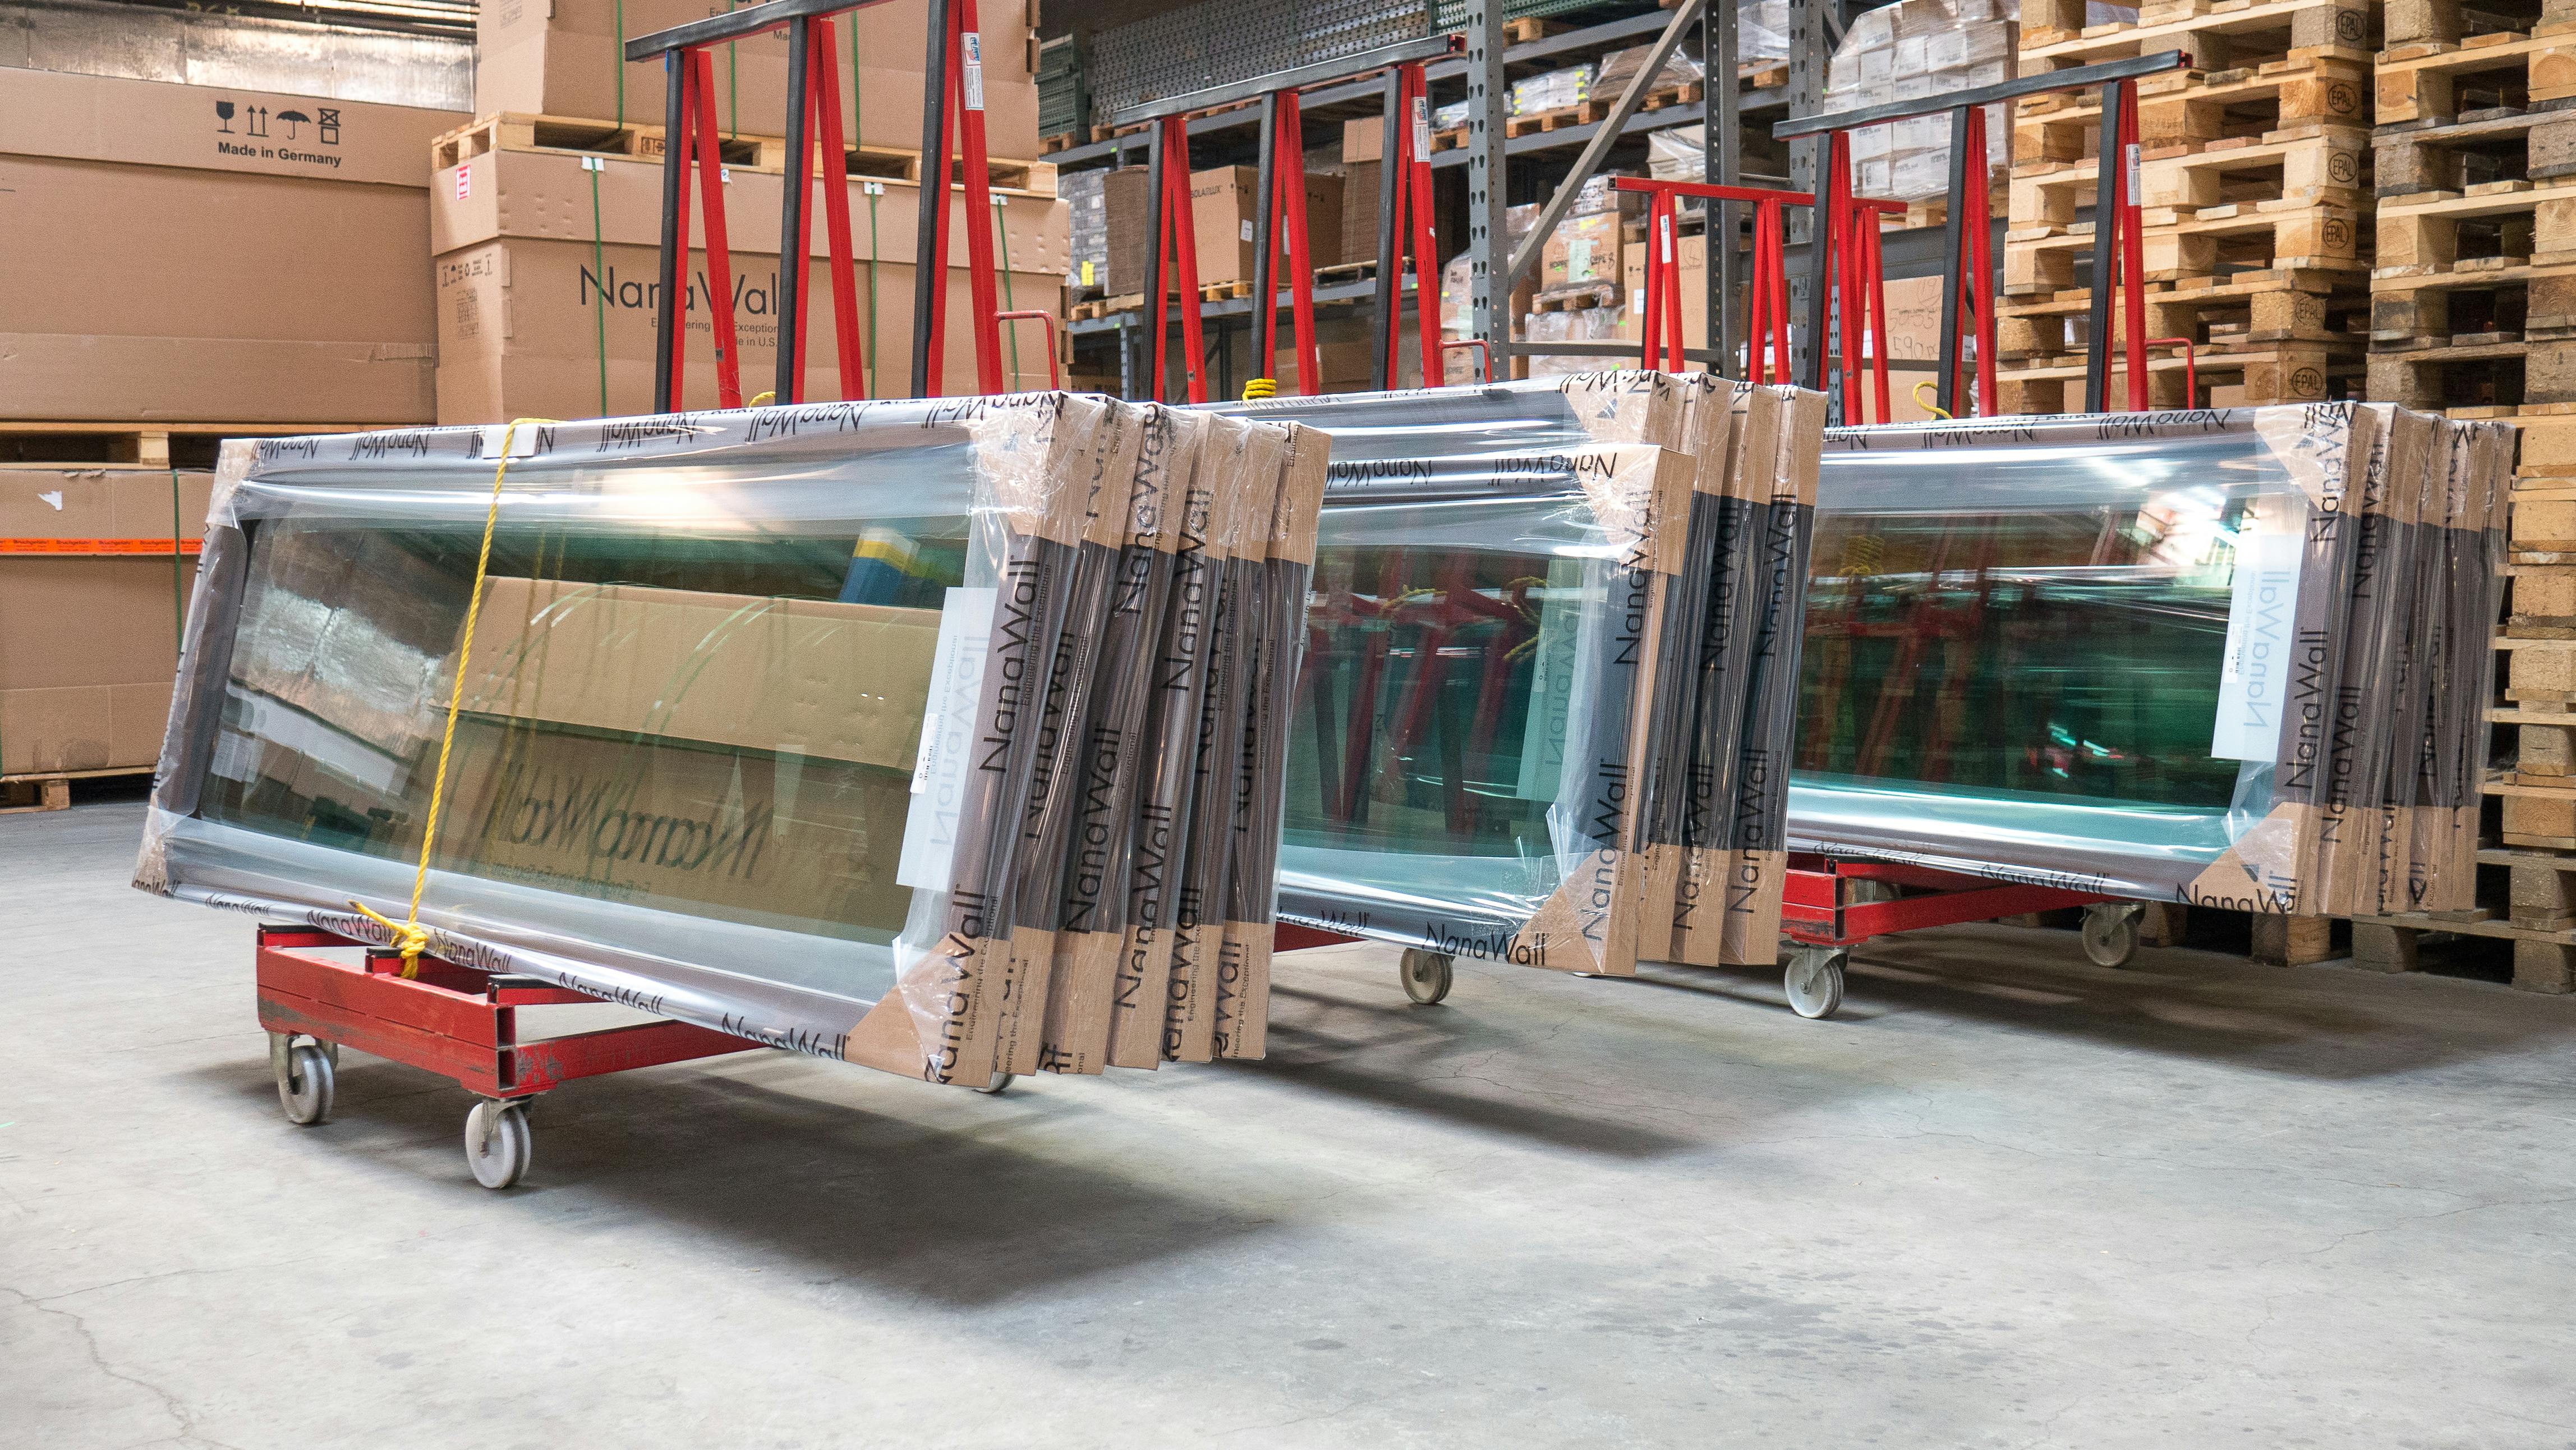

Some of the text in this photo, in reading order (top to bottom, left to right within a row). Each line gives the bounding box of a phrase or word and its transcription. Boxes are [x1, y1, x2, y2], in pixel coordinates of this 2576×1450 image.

[218, 141, 341, 168] Made in Germany
[580, 264, 777, 315] NanWal
[651, 318, 778, 334] Eering Exception
[746, 337, 755, 346] in
[349, 433, 429, 461] NanaWall
[597, 414, 699, 452] NanaWall
[745, 403, 870, 442] NanaWall
[2097, 409, 2232, 440] NanaWall
[251, 438, 320, 460] NanaWall
[1325, 459, 1432, 489] NanaWall
[2310, 414, 2344, 542] NanaW
[1114, 405, 1163, 614] NanaWa
[1161, 489, 1211, 691] NanaWall
[1613, 490, 1651, 665] NanaWall
[1700, 506, 1739, 672] NanaWall
[1021, 563, 1052, 706] Engineering the Exceptional
[978, 560, 1039, 773] NanaWall
[1216, 654, 1231, 712] Engineering
[1262, 639, 1276, 694] Exceptional
[2284, 630, 2327, 789] NanaWall
[2320, 687, 2361, 843] NanaWall
[1066, 728, 1121, 934] NanaWall
[1580, 761, 1629, 940] NanaWall
[1728, 749, 1768, 914] NanaWall
[132, 876, 181, 898] anaWall
[205, 893, 272, 916] NanaWall
[1981, 864, 2109, 895] NanaWall
[2177, 882, 2285, 915] NanaW
[1114, 803, 1172, 1008] NanaWall
[434, 928, 511, 973] NanaWall
[1192, 946, 1200, 961] the
[1423, 921, 1547, 965] NanaWall
[559, 972, 664, 1015] NanaWall
[1162, 887, 1200, 1062] anaWall
[1186, 964, 1200, 1022] Engineering
[1215, 940, 1241, 1058] aWall
[721, 1012, 850, 1061] NanaWall
[1230, 1018, 1244, 1058] ineering
